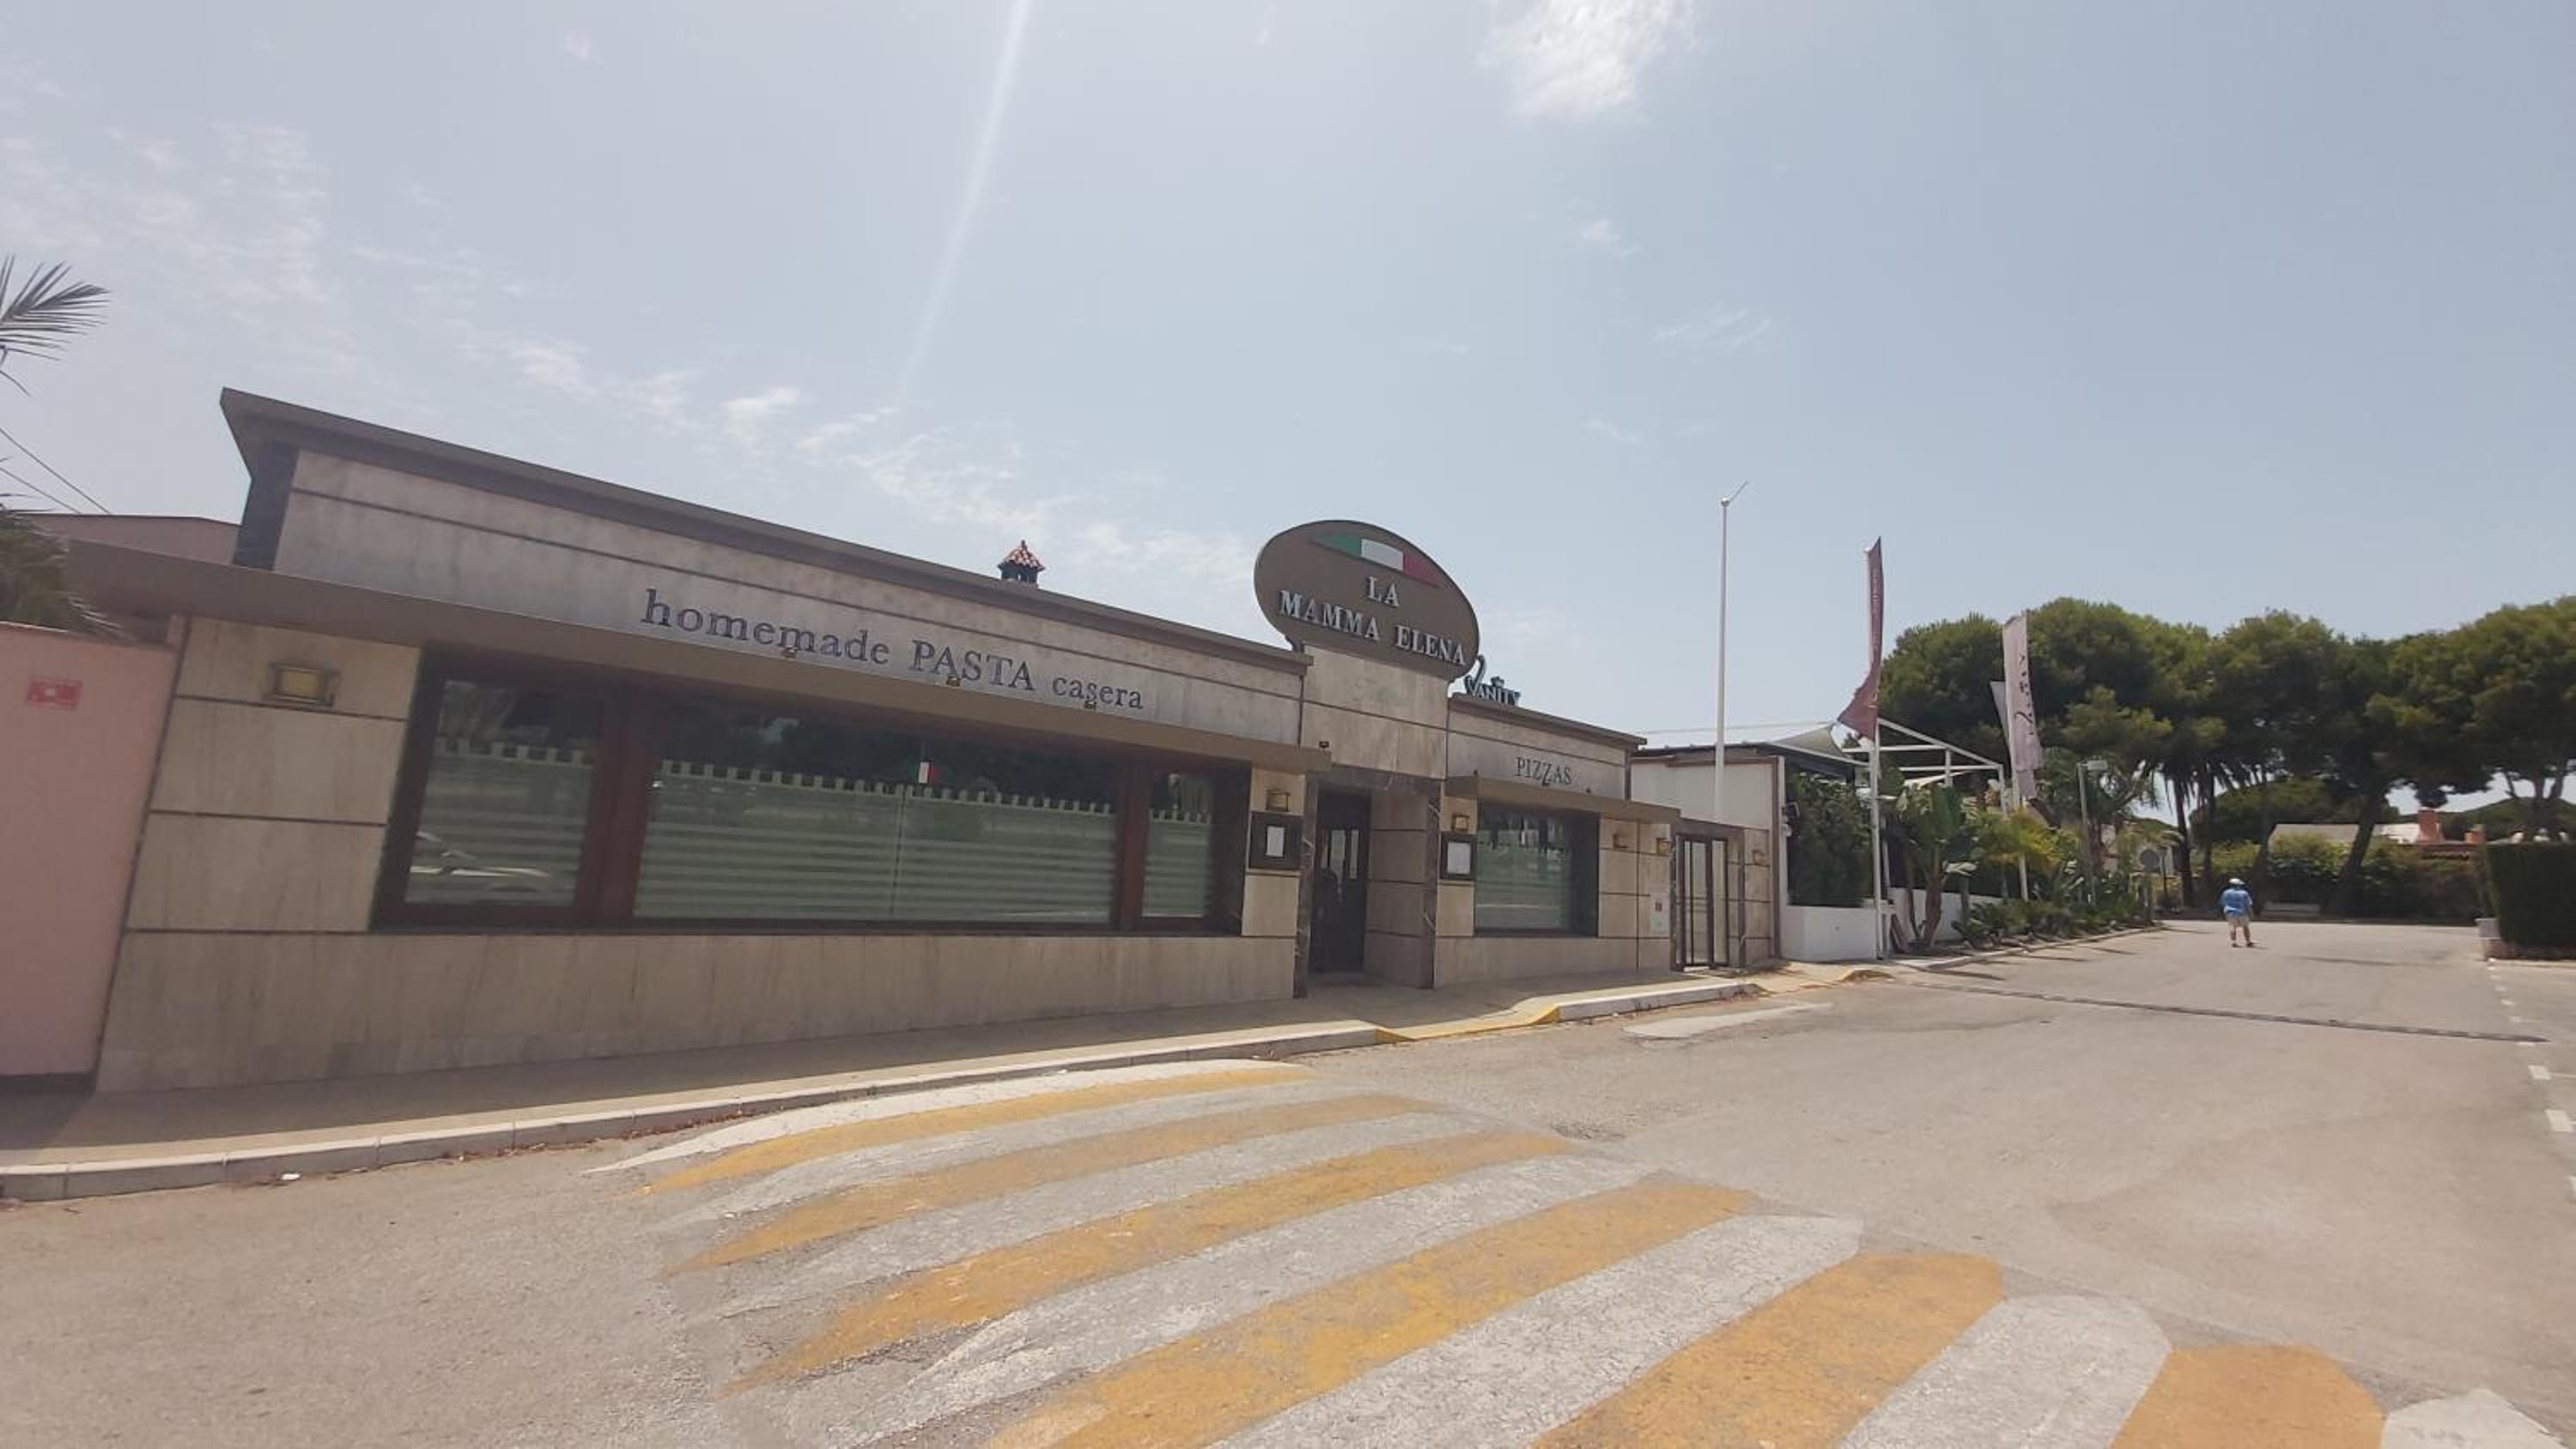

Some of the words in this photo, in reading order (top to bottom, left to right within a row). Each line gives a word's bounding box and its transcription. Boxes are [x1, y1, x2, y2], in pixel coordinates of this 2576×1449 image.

[1366, 576, 1400, 607] LA
[641, 589, 889, 664] homemade
[912, 639, 1034, 690] PASTA
[1051, 673, 1144, 712] casera
[1279, 590, 1381, 642] MAMMA
[1394, 624, 1467, 666] ELENA
[1464, 655, 1521, 707] VANITY
[1514, 756, 1572, 787] PIZZAS
